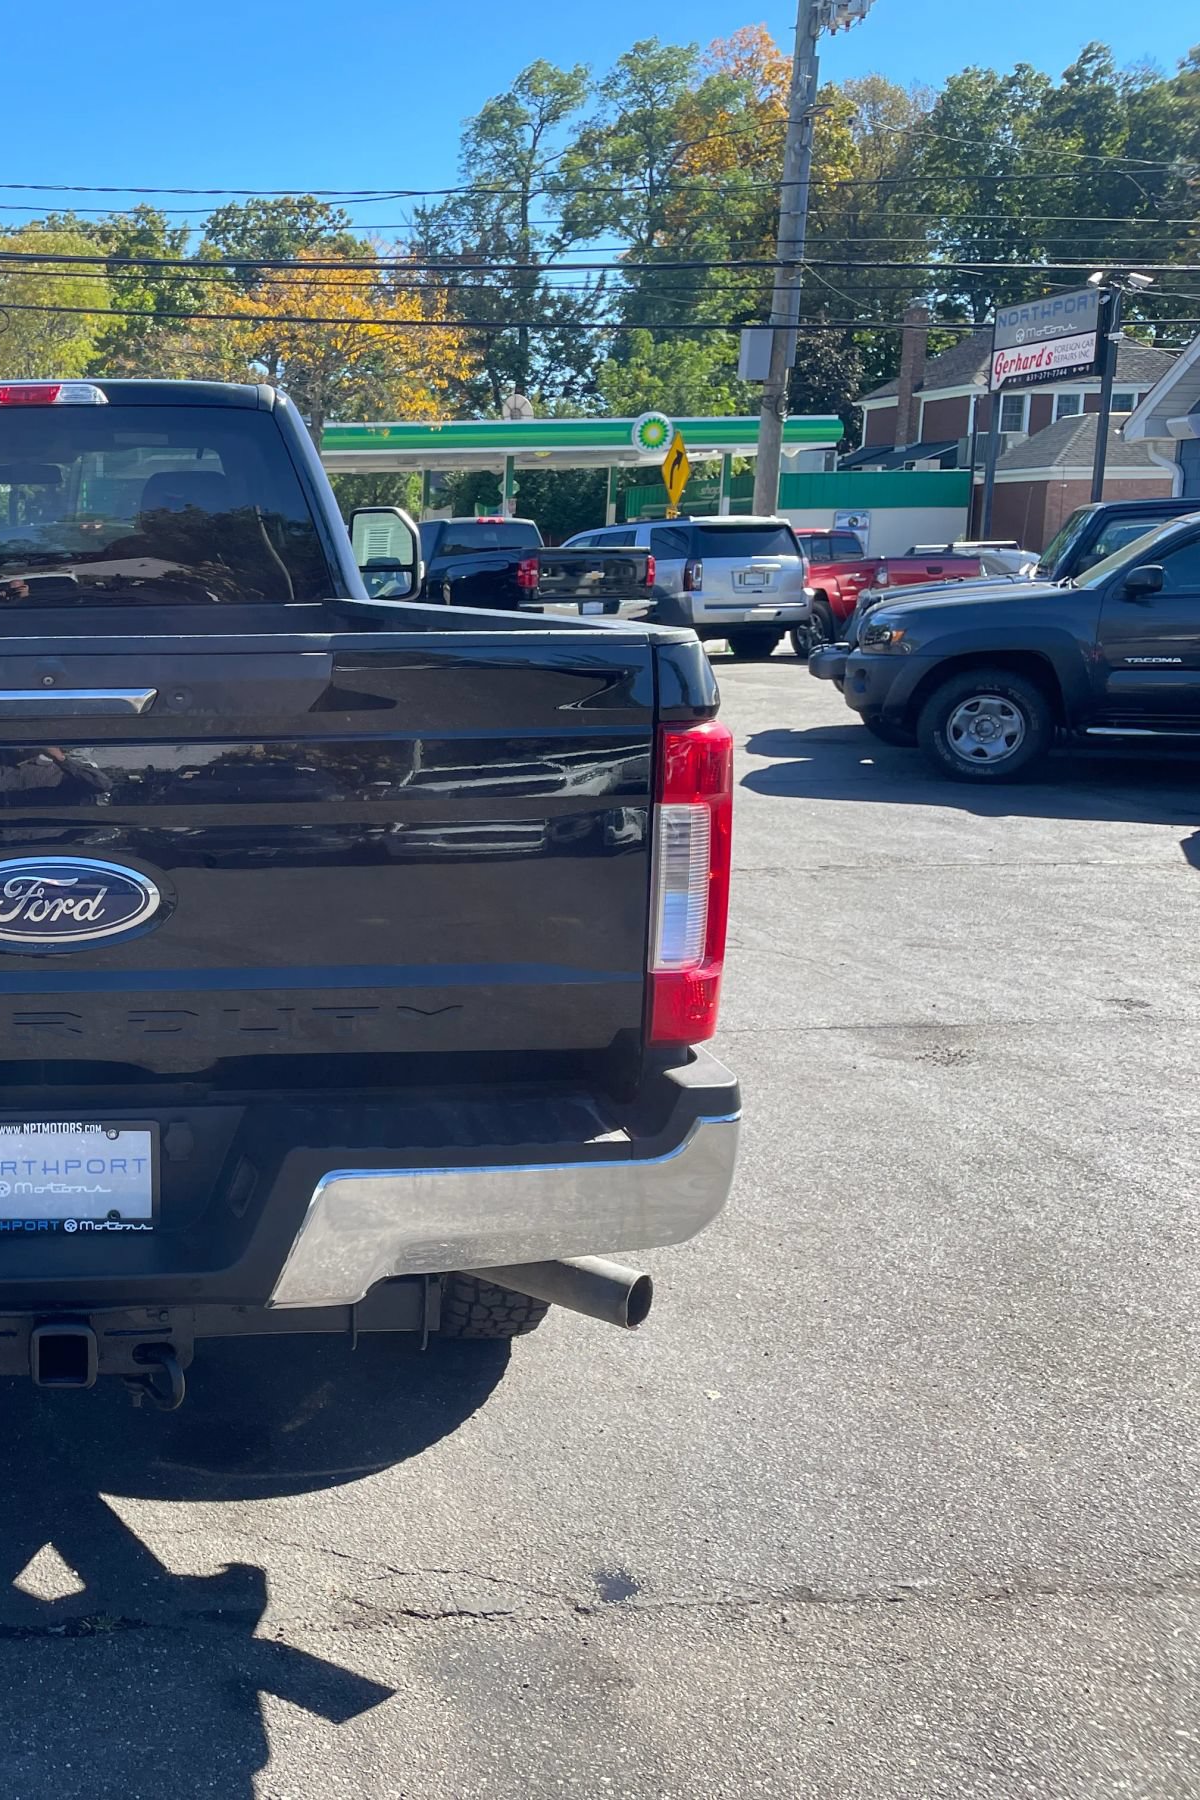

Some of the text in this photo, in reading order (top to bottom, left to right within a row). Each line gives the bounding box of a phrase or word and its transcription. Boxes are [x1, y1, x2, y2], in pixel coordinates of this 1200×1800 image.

[997, 295, 1097, 327] NORTHPORT
[1054, 338, 1094, 354] FOREIGN CAR
[994, 346, 1054, 382] Gerhard's
[1053, 351, 1077, 364] REPAIRS
[127, 1004, 464, 1040] DUTY
[14, 1182, 112, 1194] Motors
[79, 1220, 153, 1231] Motors
